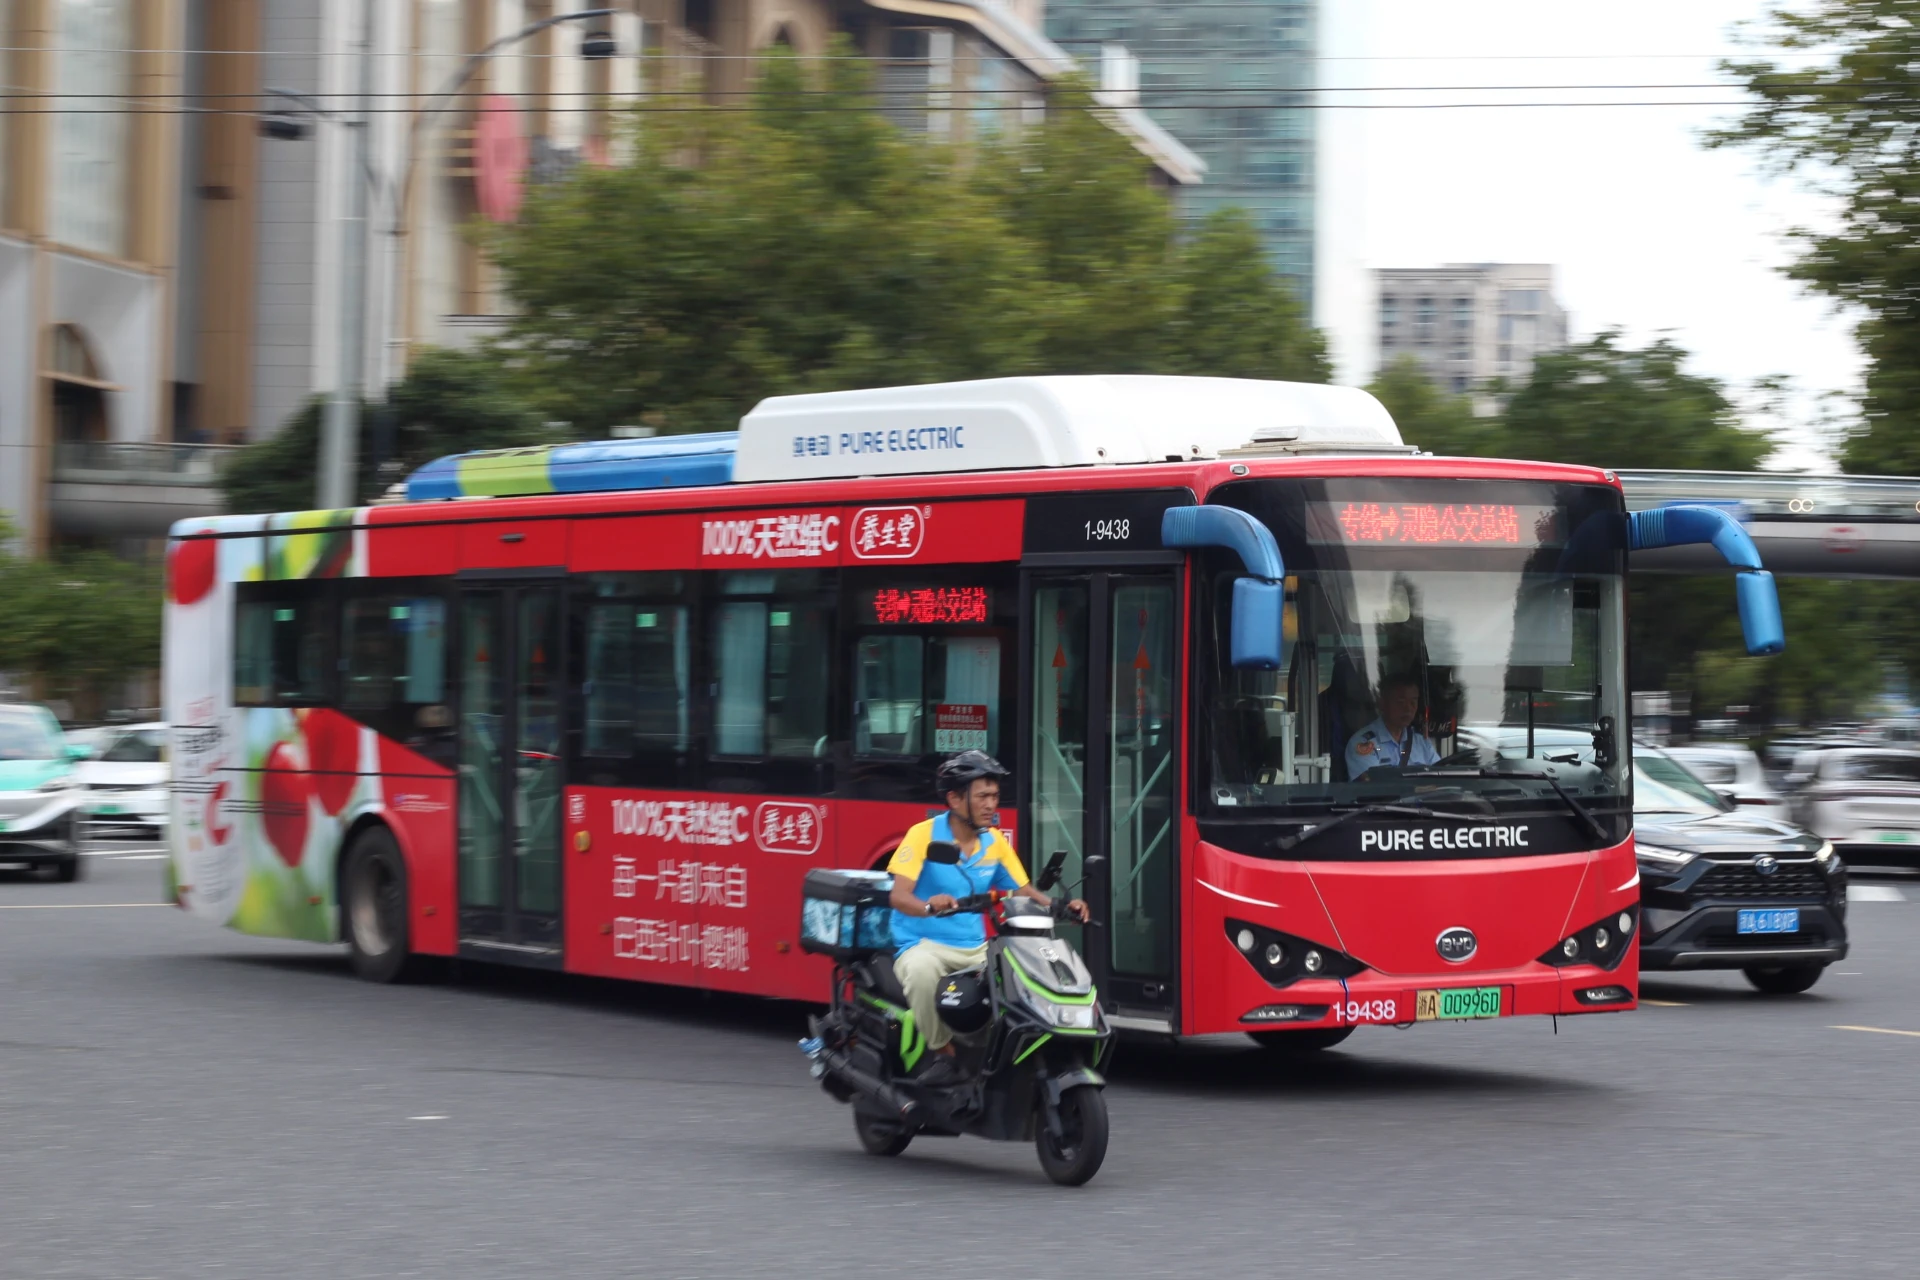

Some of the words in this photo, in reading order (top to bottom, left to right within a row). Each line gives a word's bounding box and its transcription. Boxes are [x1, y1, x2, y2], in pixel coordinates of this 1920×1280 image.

[840, 432, 884, 455] PURE
[888, 426, 964, 452] ELECTRIC
[1084, 519, 1129, 541] 1-9438
[1361, 829, 1424, 852] PURE
[1429, 825, 1529, 849] ELECTRIC
[1442, 937, 1473, 952] BYD
[1332, 999, 1396, 1022] 1-9438
